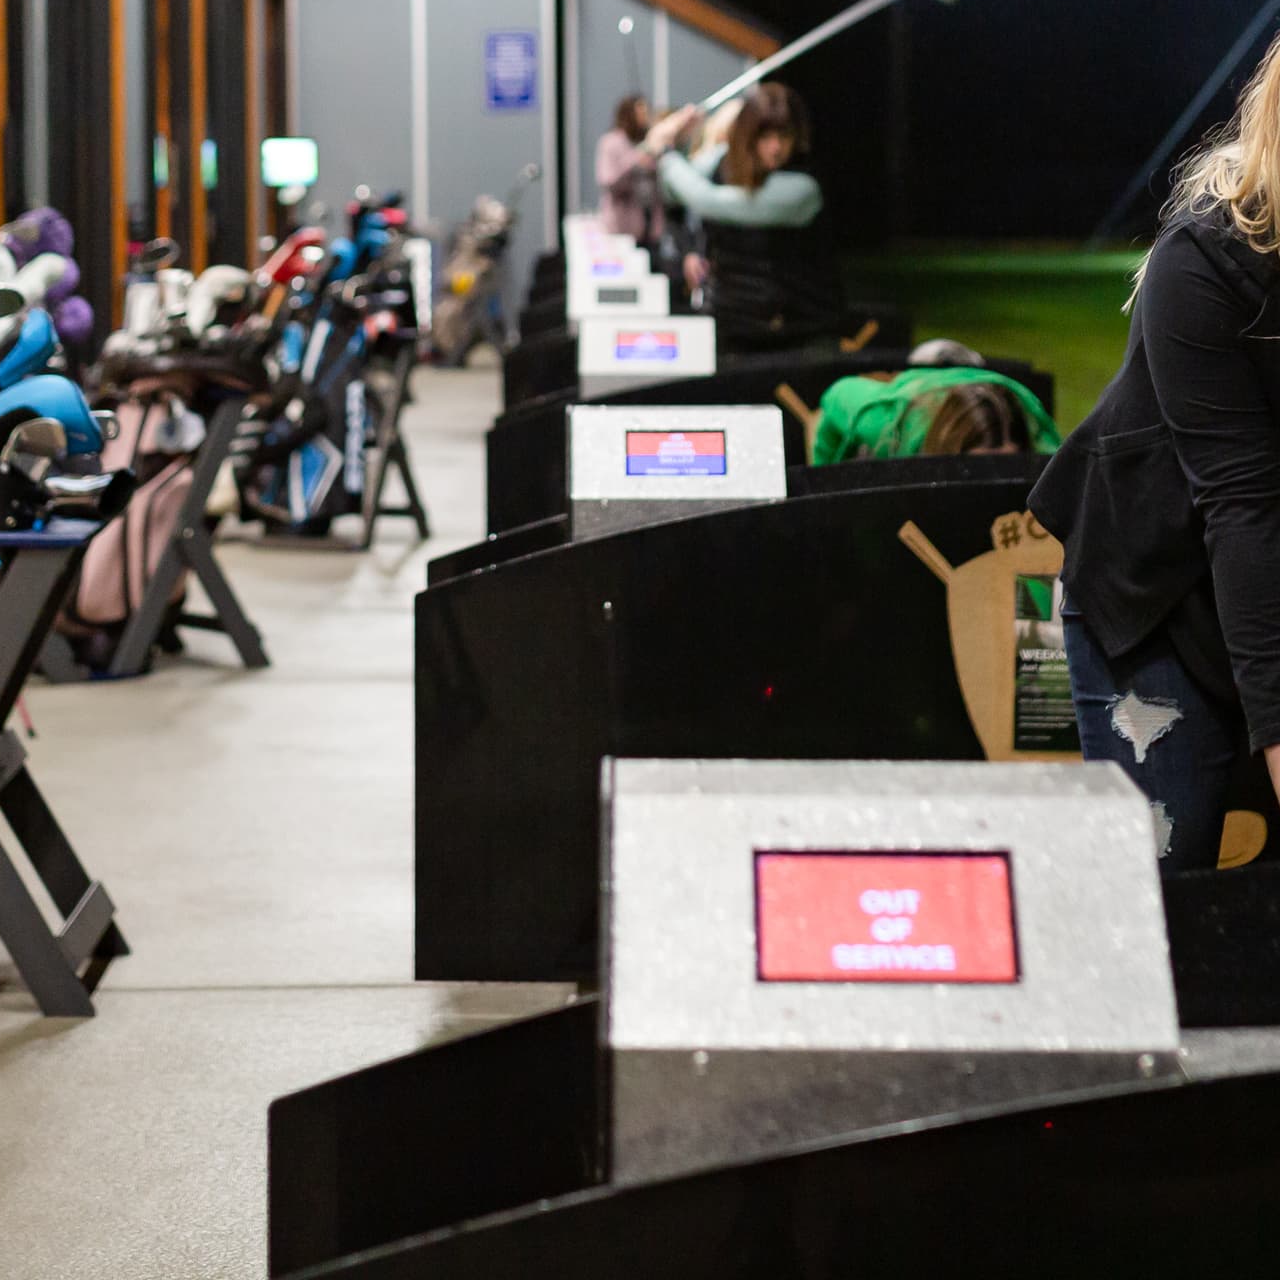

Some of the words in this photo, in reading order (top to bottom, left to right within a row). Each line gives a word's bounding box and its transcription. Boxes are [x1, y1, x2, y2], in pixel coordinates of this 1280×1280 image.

[859, 889, 919, 915] OUT
[871, 916, 913, 942] OF
[831, 944, 956, 970] SERVICE
